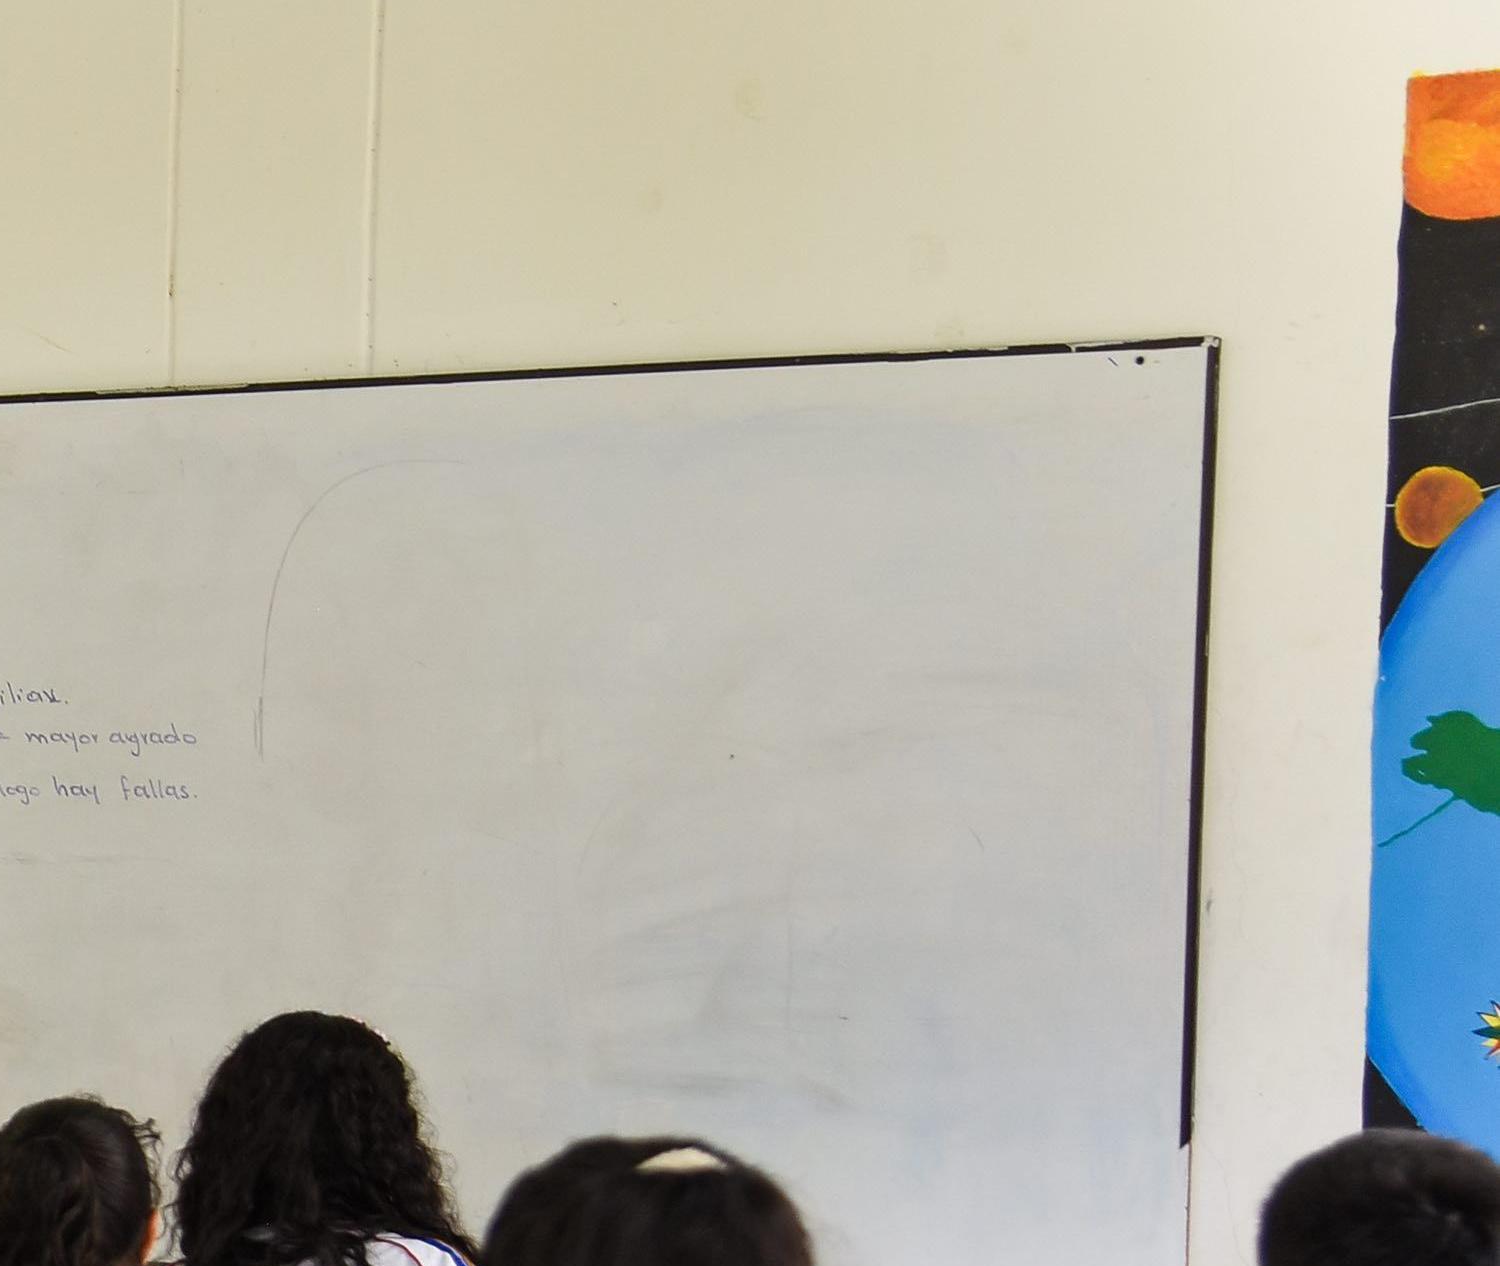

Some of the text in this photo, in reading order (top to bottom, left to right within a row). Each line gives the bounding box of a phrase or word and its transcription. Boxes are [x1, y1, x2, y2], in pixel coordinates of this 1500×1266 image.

[24, 730, 99, 752] mayor
[109, 722, 198, 758] agrado
[52, 774, 101, 805] hay
